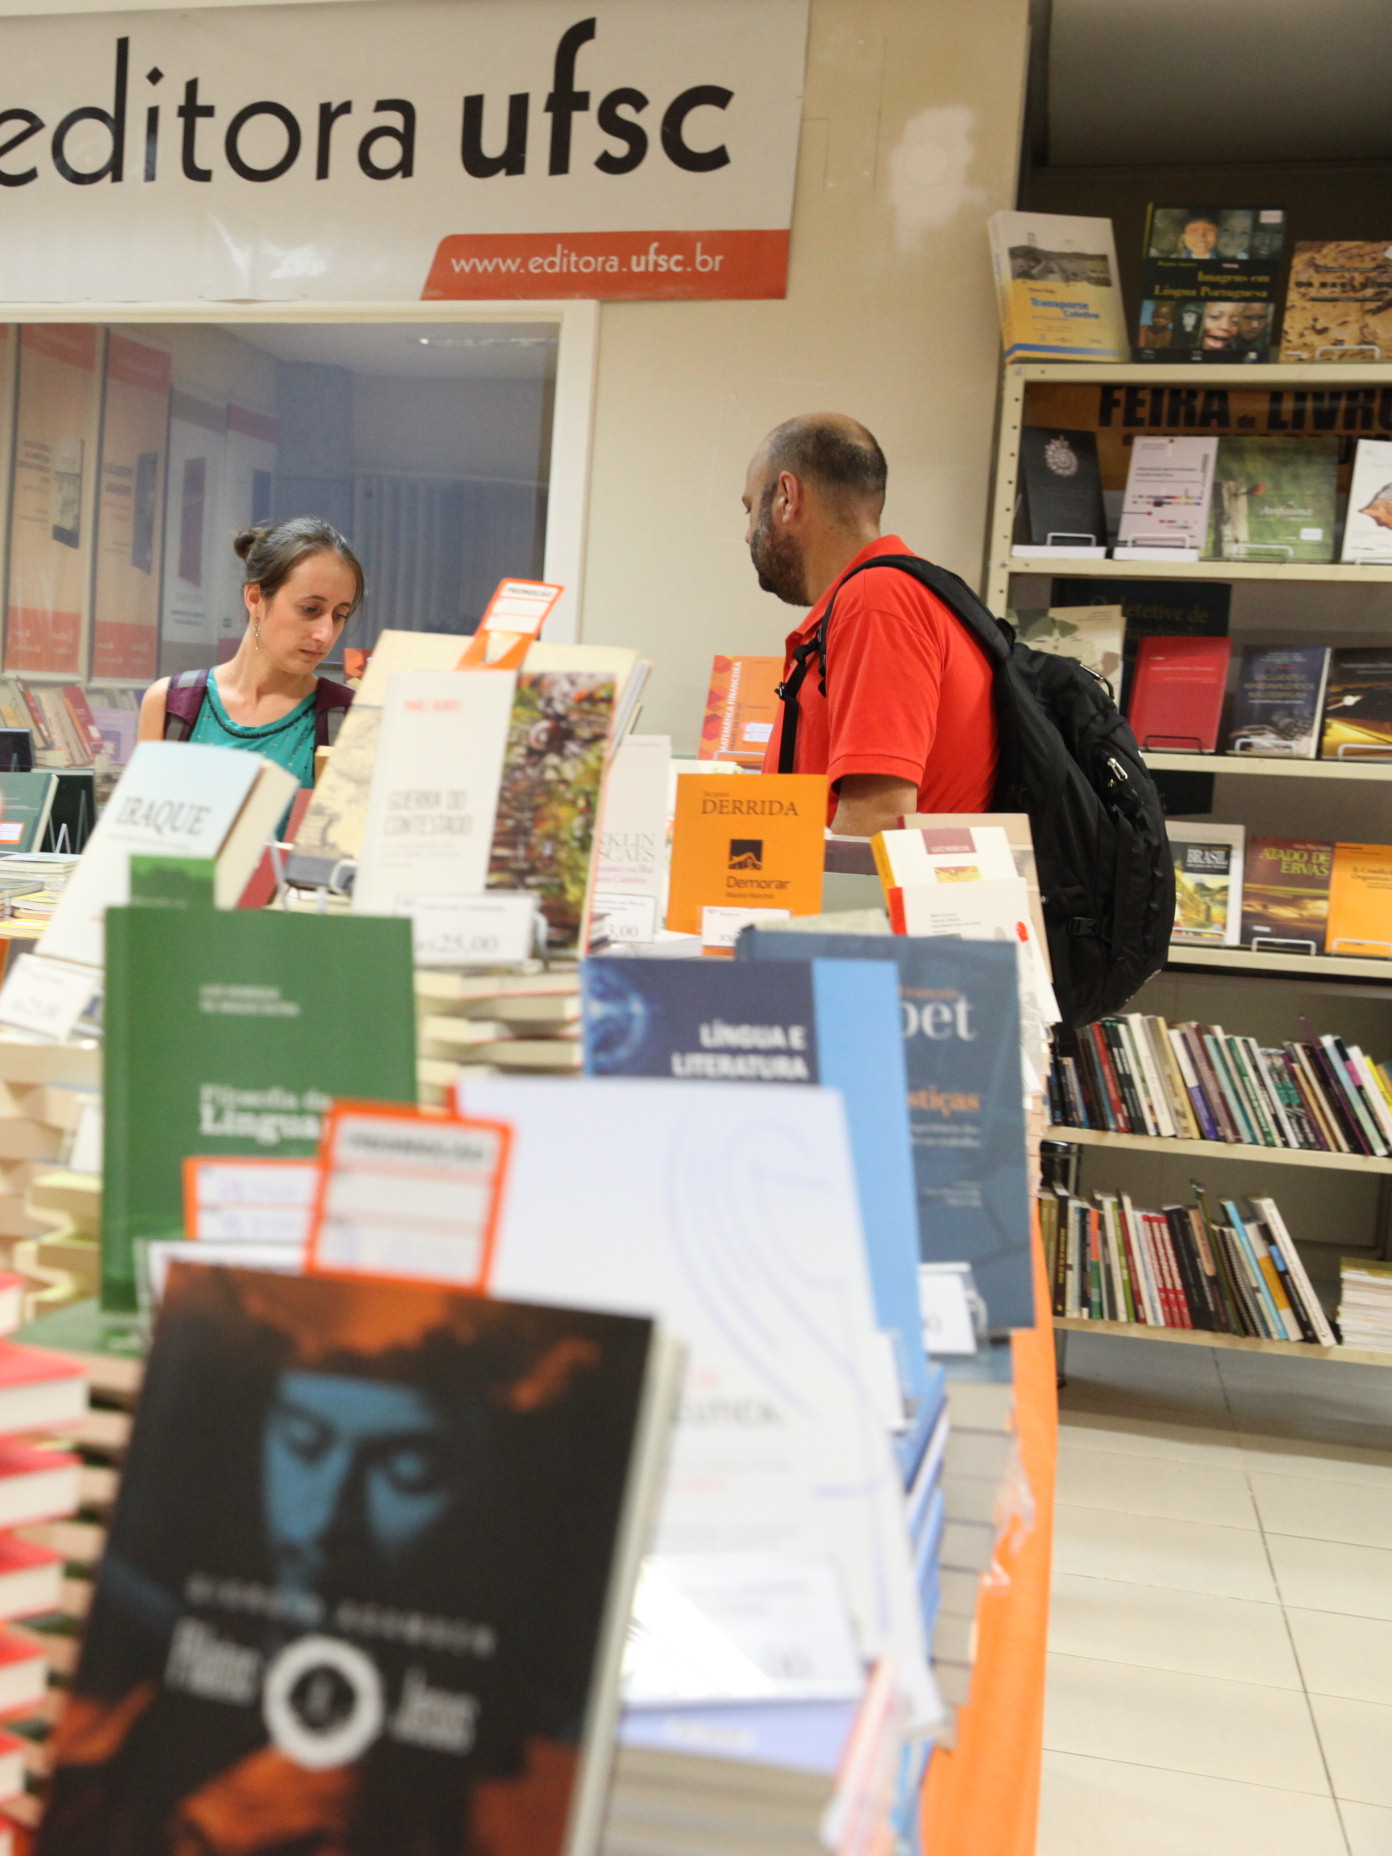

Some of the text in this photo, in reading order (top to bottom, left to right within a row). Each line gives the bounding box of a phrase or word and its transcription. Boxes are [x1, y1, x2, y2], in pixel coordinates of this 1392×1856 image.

[459, 16, 735, 179] ufsc
[451, 242, 724, 273] www.editora.ufsc.br
[1098, 384, 1231, 428] FEIRA
[114, 796, 211, 836] IRAQUE
[701, 798, 800, 816] DERRIDA
[1186, 848, 1229, 865] BRASIL
[1260, 848, 1309, 862] ATADO
[1311, 851, 1331, 865] DE
[1280, 861, 1330, 877] ERVAS
[726, 876, 791, 890] Demorar
[699, 1018, 806, 1049] LÍNGUA E
[671, 1052, 809, 1080] LITERATURA
